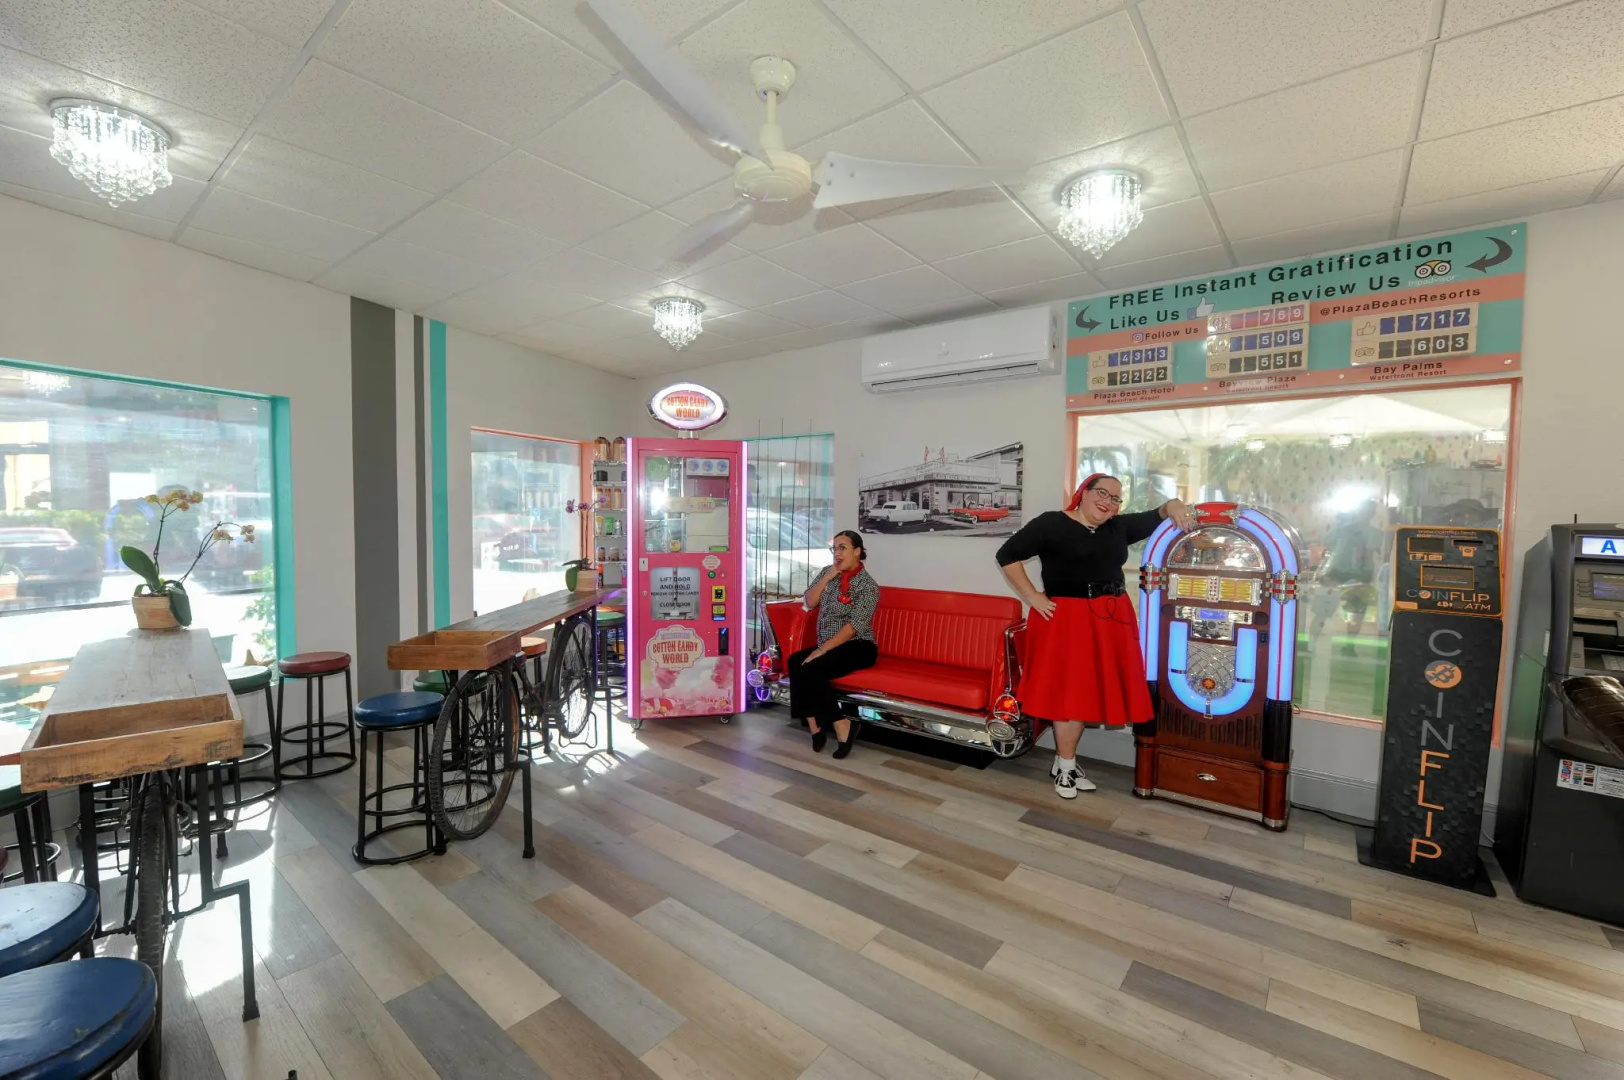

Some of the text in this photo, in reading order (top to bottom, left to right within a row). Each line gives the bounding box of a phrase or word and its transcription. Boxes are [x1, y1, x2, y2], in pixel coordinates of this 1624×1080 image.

[1109, 240, 1453, 310] FREE Instant Gratification
[1408, 274, 1456, 287] tripadvisor
[1271, 275, 1401, 305] Review Us
[1319, 288, 1481, 316] @PlazaBeachResorts
[1110, 309, 1180, 330] Like Us
[1420, 312, 1466, 327] 717
[1145, 327, 1199, 340] Follow Us
[1261, 331, 1301, 345] 509
[1417, 338, 1464, 351] 603
[1121, 347, 1167, 363] 4313
[1260, 354, 1298, 369] 551
[1369, 369, 1447, 381] Waterfront Resort
[1374, 362, 1443, 375] Bay Palms
[1121, 369, 1165, 383] 2222
[1267, 375, 1297, 383] Plaza
[1094, 386, 1176, 400] Plaza Beach Hotel
[676, 408, 700, 418] WORLD
[1464, 602, 1491, 611] ATM
[653, 640, 698, 653] COTTON CANDY
[662, 652, 689, 664] WORLD
